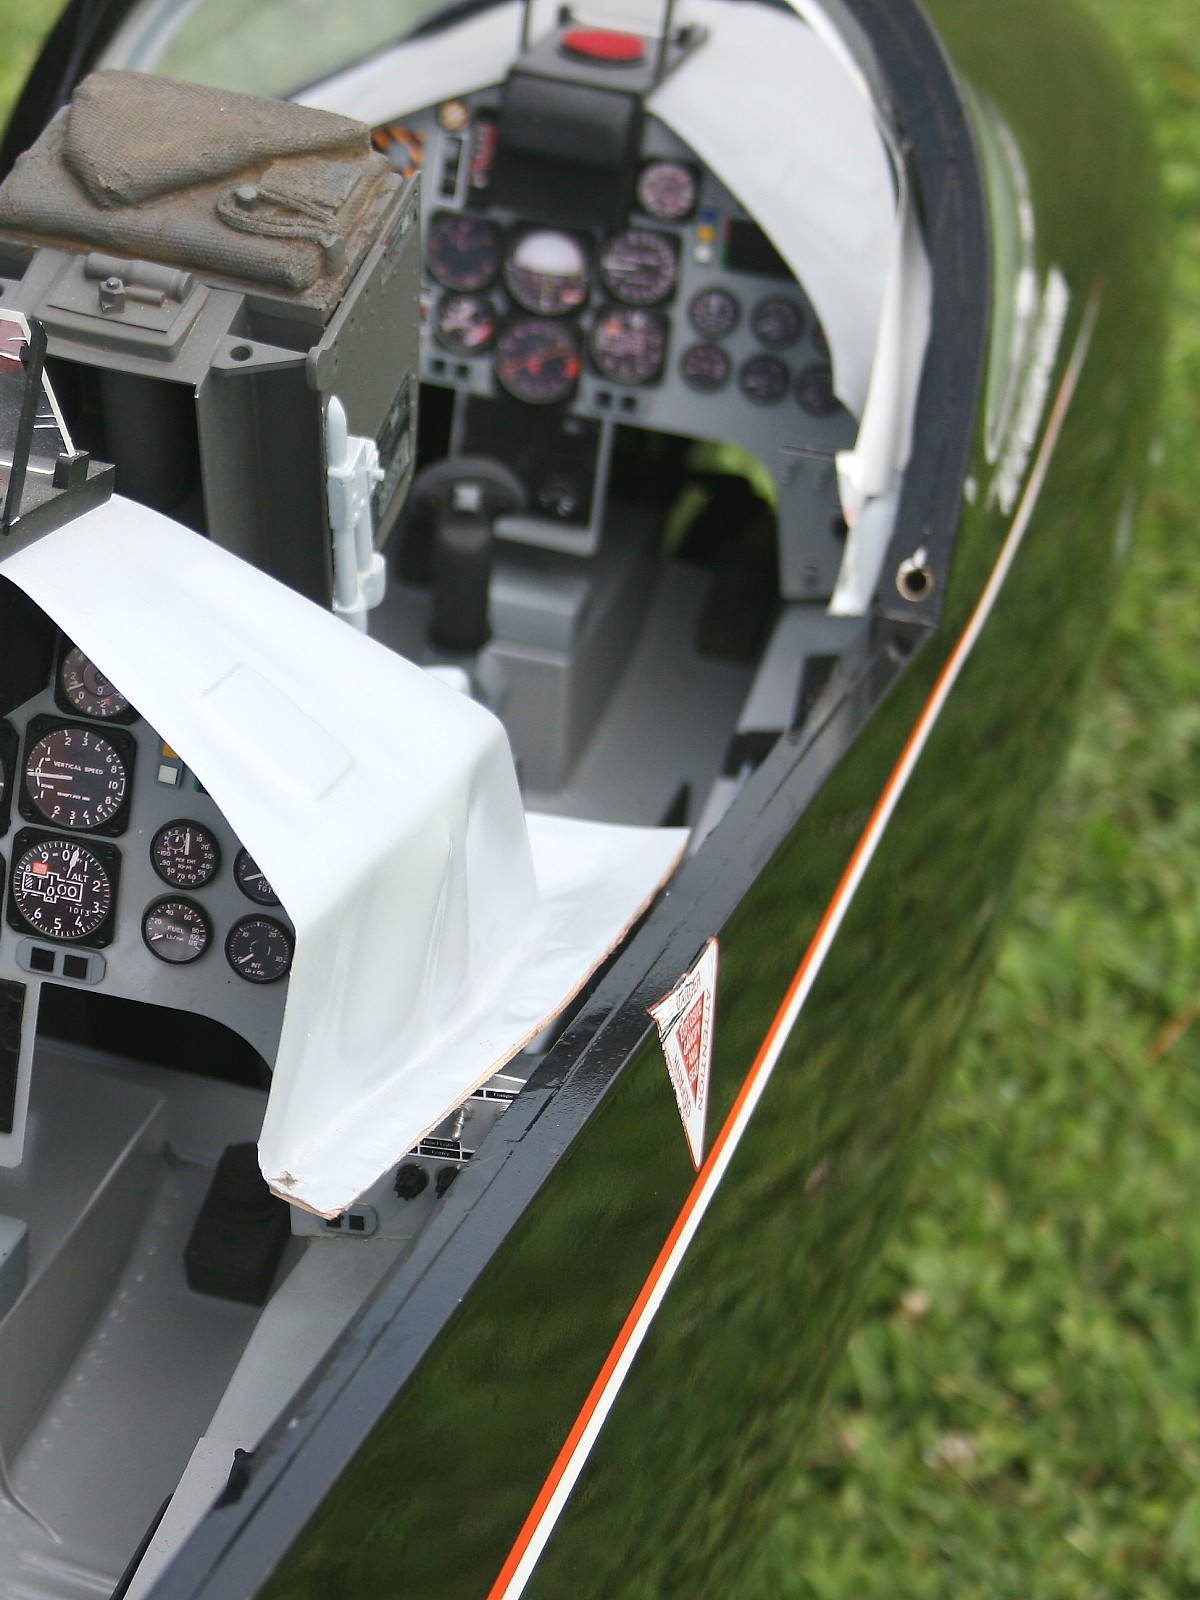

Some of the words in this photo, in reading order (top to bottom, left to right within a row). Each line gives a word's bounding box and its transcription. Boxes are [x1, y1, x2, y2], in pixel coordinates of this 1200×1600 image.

[70, 672, 76, 680] 2
[78, 692, 84, 700] 0
[65, 737, 72, 746] 2
[82, 738, 88, 746] 3
[94, 744, 100, 752] 4
[54, 760, 82, 772] VERTICAL
[84, 766, 104, 774] SPEED
[111, 766, 116, 774] 8
[108, 780, 118, 790] 10
[105, 796, 111, 804] 8
[54, 806, 60, 814] 2
[97, 804, 102, 812] 6
[70, 811, 76, 819] 3
[42, 852, 48, 864] 9
[62, 850, 70, 860] 0
[71, 873, 88, 882] ALT
[92, 880, 100, 892] 2
[69, 906, 90, 917] 1013
[92, 902, 100, 914] 3
[34, 908, 42, 918] 6
[54, 918, 62, 930] 5
[74, 916, 82, 928] 4
[698, 988, 711, 1111] ATTENTION
